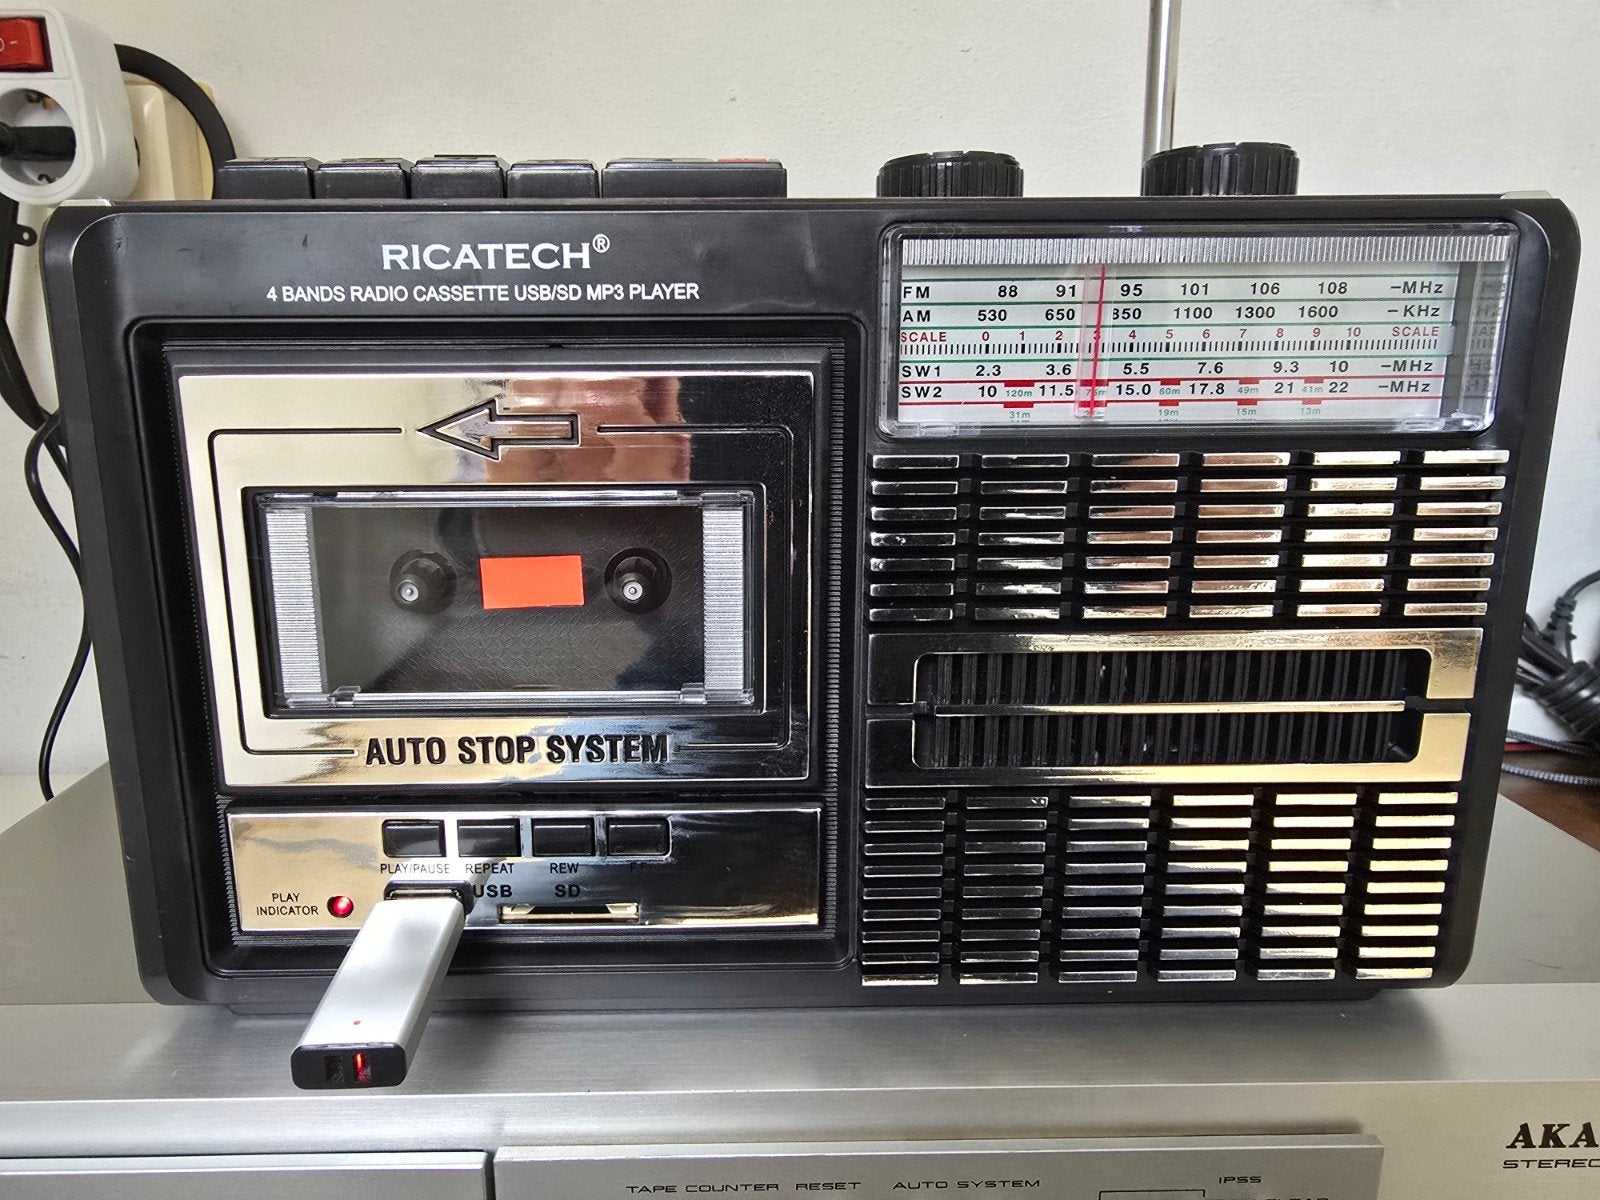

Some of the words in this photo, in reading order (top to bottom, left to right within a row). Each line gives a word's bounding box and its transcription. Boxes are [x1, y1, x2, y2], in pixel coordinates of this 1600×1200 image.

[266, 286, 277, 302] 4
[282, 285, 345, 302] BANDS
[350, 285, 408, 302] RADIO
[413, 285, 509, 302] CASSETTE
[514, 284, 582, 302] USB/SD
[586, 284, 625, 301] MP3
[629, 283, 700, 300] PLAYER
[903, 286, 930, 299] FM
[998, 285, 1018, 298] 88
[1056, 284, 1076, 297] 91
[1120, 283, 1143, 297] 95
[1181, 283, 1209, 296] 101
[1250, 282, 1280, 295] 106
[1318, 281, 1348, 294] 108
[903, 310, 931, 322] AM
[977, 309, 1007, 322] 530
[1045, 308, 1075, 321] 650
[1174, 307, 1213, 319] 1100
[1236, 306, 1275, 319] 1300
[1299, 305, 1338, 318] 1600
[900, 331, 947, 342] SCALE
[981, 331, 990, 342] 0
[1019, 331, 1026, 341] 1
[1055, 330, 1064, 340] 2
[1128, 329, 1137, 340] 4
[1165, 329, 1174, 339] 5
[1202, 329, 1211, 339] 6
[1240, 328, 1248, 338] 7
[1276, 328, 1284, 338] 8
[1313, 327, 1321, 337] 9
[1347, 327, 1362, 337] 10
[1392, 326, 1439, 337] SCALE
[902, 365, 942, 378] SW1
[976, 364, 1001, 377] 2.3
[1046, 363, 1072, 376] 3.6
[1123, 362, 1149, 375] 5.5
[1198, 362, 1224, 374] 7.6
[1273, 361, 1299, 373] 9.3
[1329, 360, 1349, 373] 10
[901, 386, 942, 398] SW2
[978, 385, 997, 397] 10
[1005, 389, 1032, 397] 120m
[1039, 384, 1075, 396] 11.5
[1115, 383, 1151, 396] 15.0
[1159, 387, 1180, 395] 60m
[1189, 383, 1225, 395] 17.8
[1237, 386, 1258, 394] 49m
[1274, 382, 1294, 394] 21
[1328, 382, 1349, 393] 22
[1009, 411, 1030, 419] 31m
[366, 736, 450, 765] AUTO
[458, 735, 536, 765] STOP
[546, 733, 669, 764] SYSTEM
[380, 863, 450, 874] PLAY/PAUSE
[465, 862, 515, 874] REPEAT
[550, 862, 579, 874] REW
[272, 893, 300, 903] PLAY
[472, 884, 513, 898] USB
[555, 884, 581, 898] SD
[256, 906, 319, 916] INDICATOR
[1505, 1122, 1600, 1149] AKA
[893, 1180, 948, 1190] AUTO
[957, 1179, 1041, 1189] SYSTEM
[1219, 1176, 1262, 1184] IPSS
[625, 1184, 677, 1194] TAPE
[685, 1183, 779, 1193] COUNTER
[795, 1182, 861, 1192] RESET
